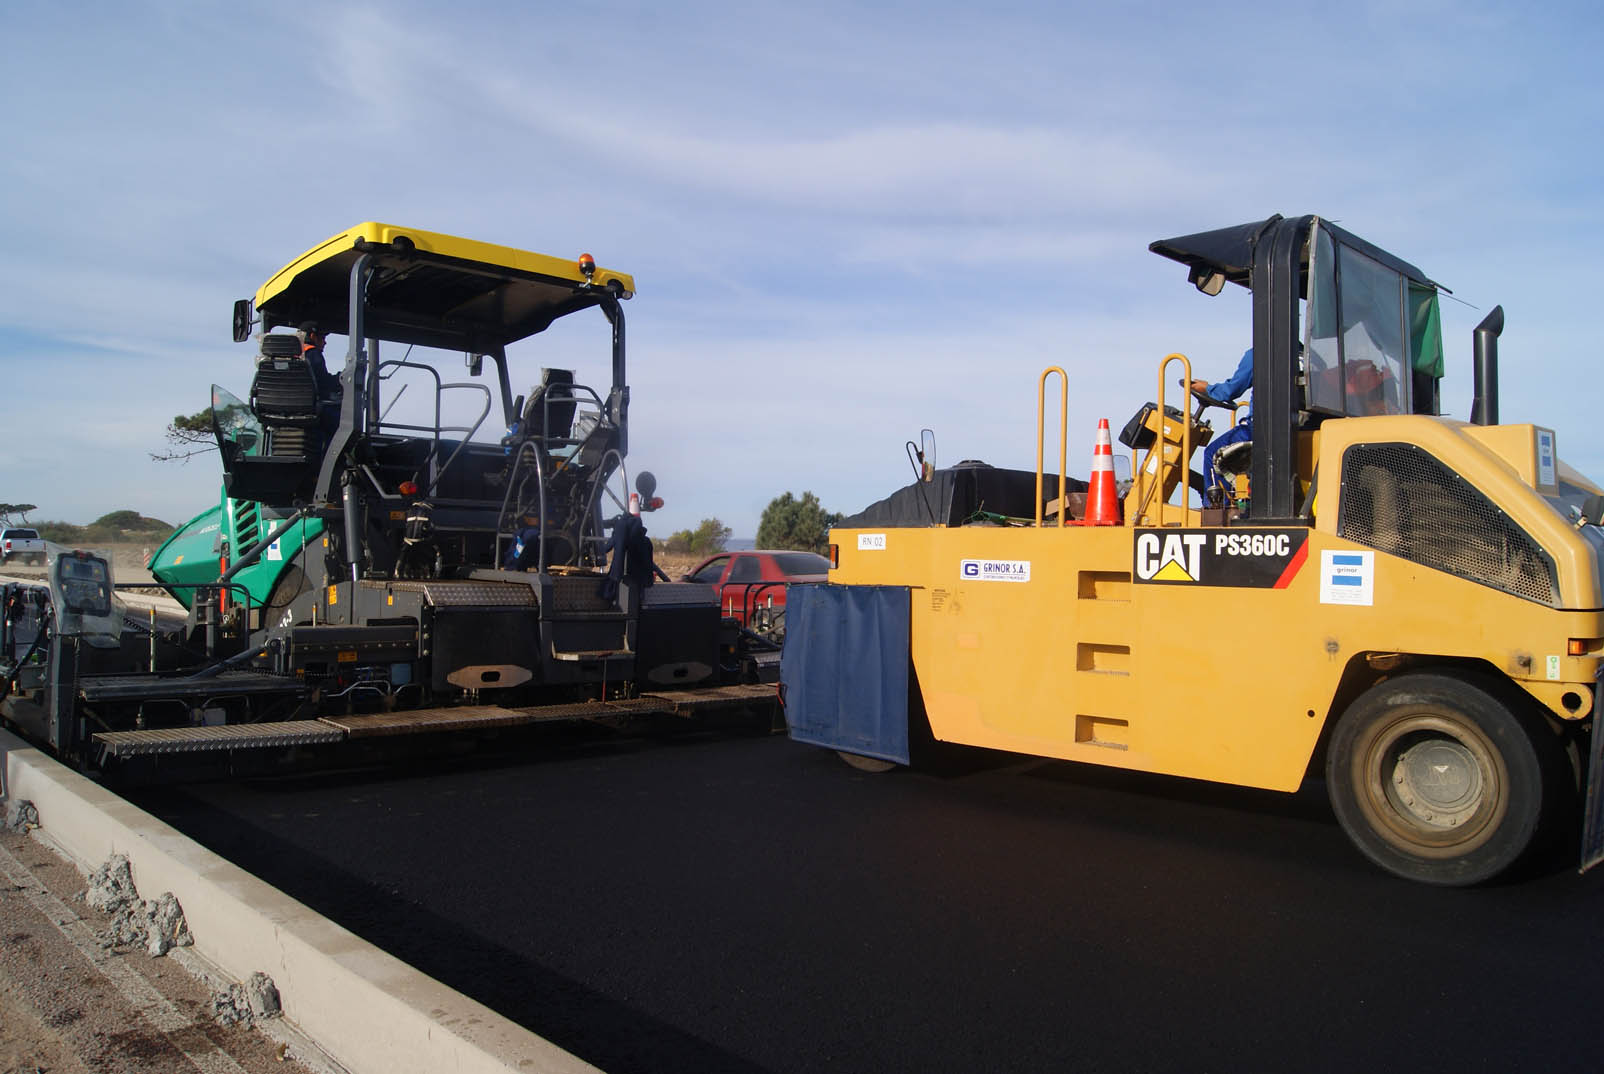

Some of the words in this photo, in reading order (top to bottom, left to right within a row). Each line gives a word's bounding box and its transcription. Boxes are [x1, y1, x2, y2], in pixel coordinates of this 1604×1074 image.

[1137, 533, 1206, 581] CAT
[1215, 534, 1290, 556] PS360C
[964, 563, 979, 576] G
[983, 563, 1011, 573] GRINOR
[1012, 563, 1026, 574] S.A.
